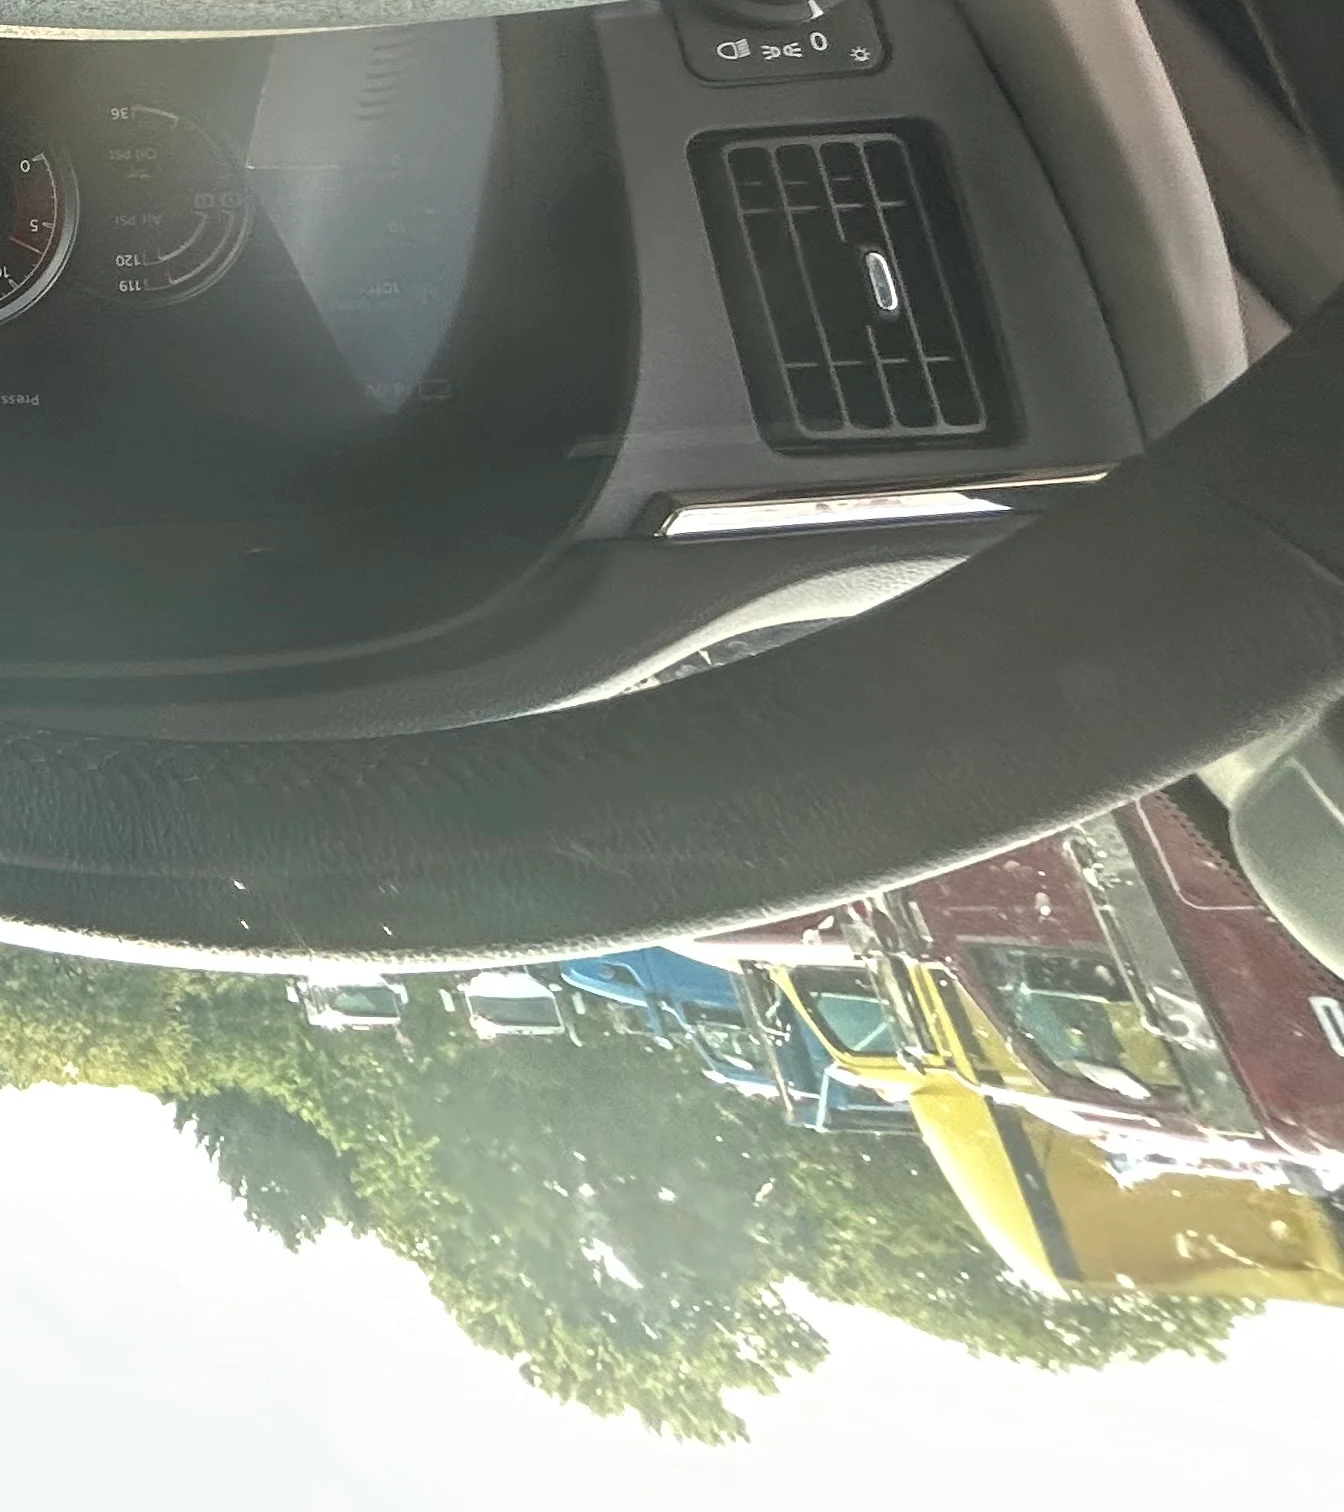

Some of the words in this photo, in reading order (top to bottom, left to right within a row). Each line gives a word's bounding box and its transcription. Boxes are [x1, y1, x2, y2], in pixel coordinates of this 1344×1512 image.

[110, 107, 129, 120] 36
[109, 148, 131, 160] PSI
[135, 148, 157, 160] Oil
[19, 159, 31, 173] 0
[29, 219, 38, 231] 5
[115, 214, 135, 226] PSI
[142, 213, 162, 225] Air
[115, 254, 140, 267] 120
[118, 279, 141, 292] 119
[0, 394, 40, 406] Press
